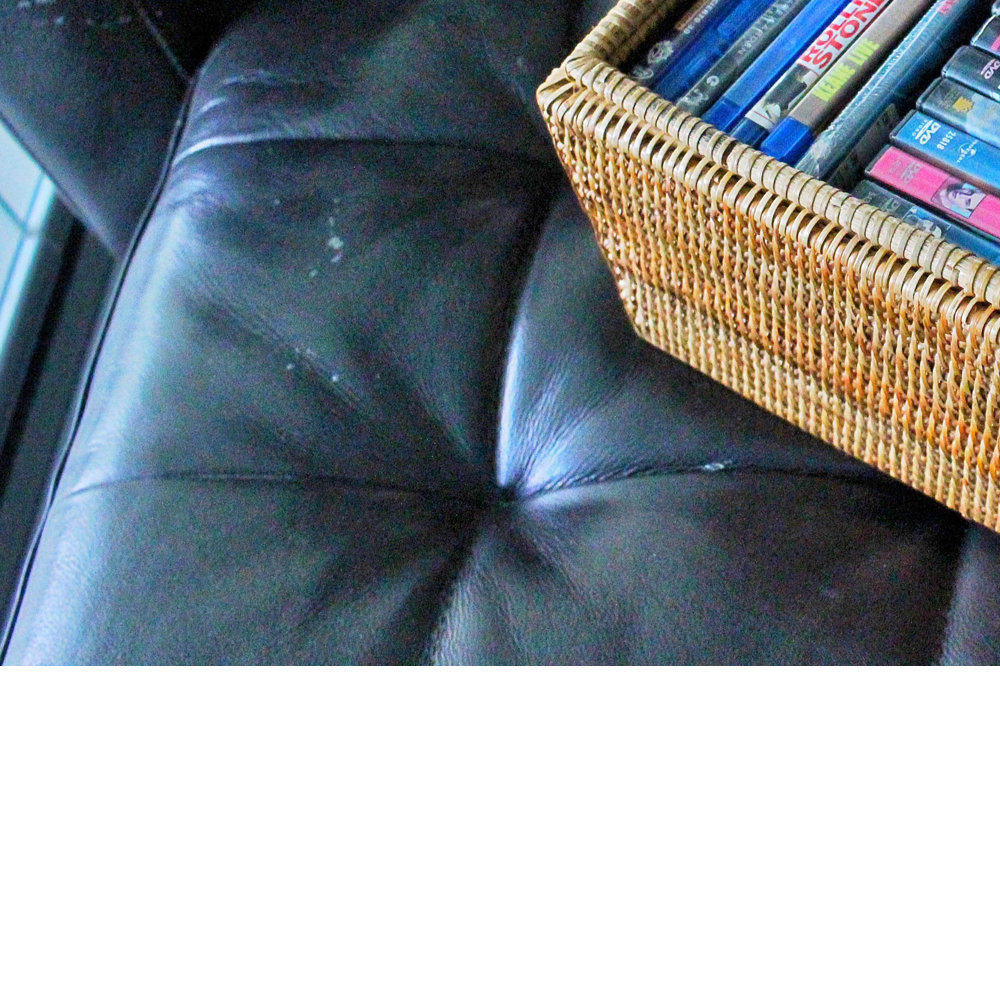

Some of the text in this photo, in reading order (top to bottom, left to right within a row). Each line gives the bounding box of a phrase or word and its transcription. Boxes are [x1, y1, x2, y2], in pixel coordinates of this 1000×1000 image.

[811, 32, 882, 106] KEANE LIVE
[918, 118, 941, 148] DVD
[935, 127, 956, 153] 25818
